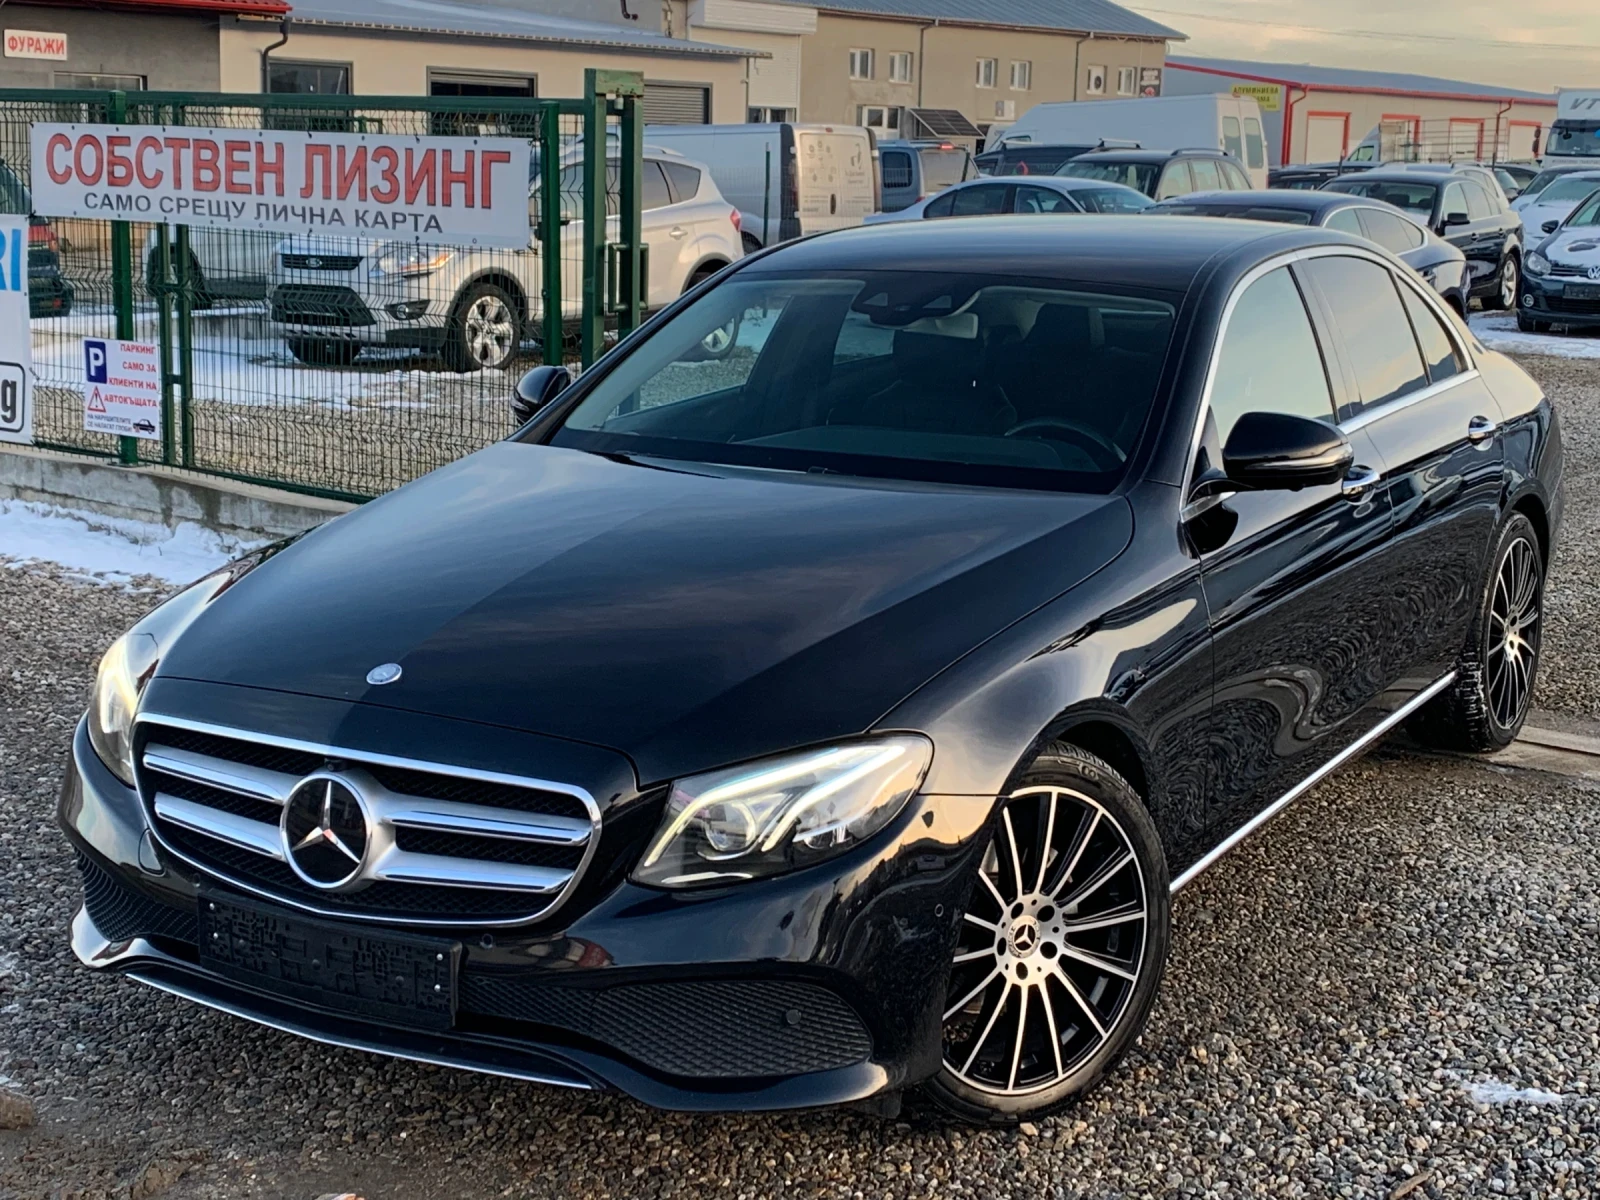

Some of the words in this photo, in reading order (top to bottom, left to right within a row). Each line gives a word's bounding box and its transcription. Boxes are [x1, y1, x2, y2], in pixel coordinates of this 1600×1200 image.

[8, 35, 65, 55] ФУРАЖИ
[46, 132, 285, 197] СОБСТВЕН
[299, 143, 511, 209] ЛИЗИНГ
[84, 192, 151, 213] САМО
[159, 196, 246, 219] СРЕЩУ
[254, 202, 346, 227] ЛИЧНА
[354, 209, 443, 234] КАРТА
[120, 343, 155, 355] ПАРКИНГ
[122, 361, 144, 371] САМО
[147, 364, 156, 372] ЗА
[109, 377, 143, 388] КЛИЕНТИ
[146, 382, 157, 390] НА
[104, 394, 157, 407] АВТОКЪЩАТА
